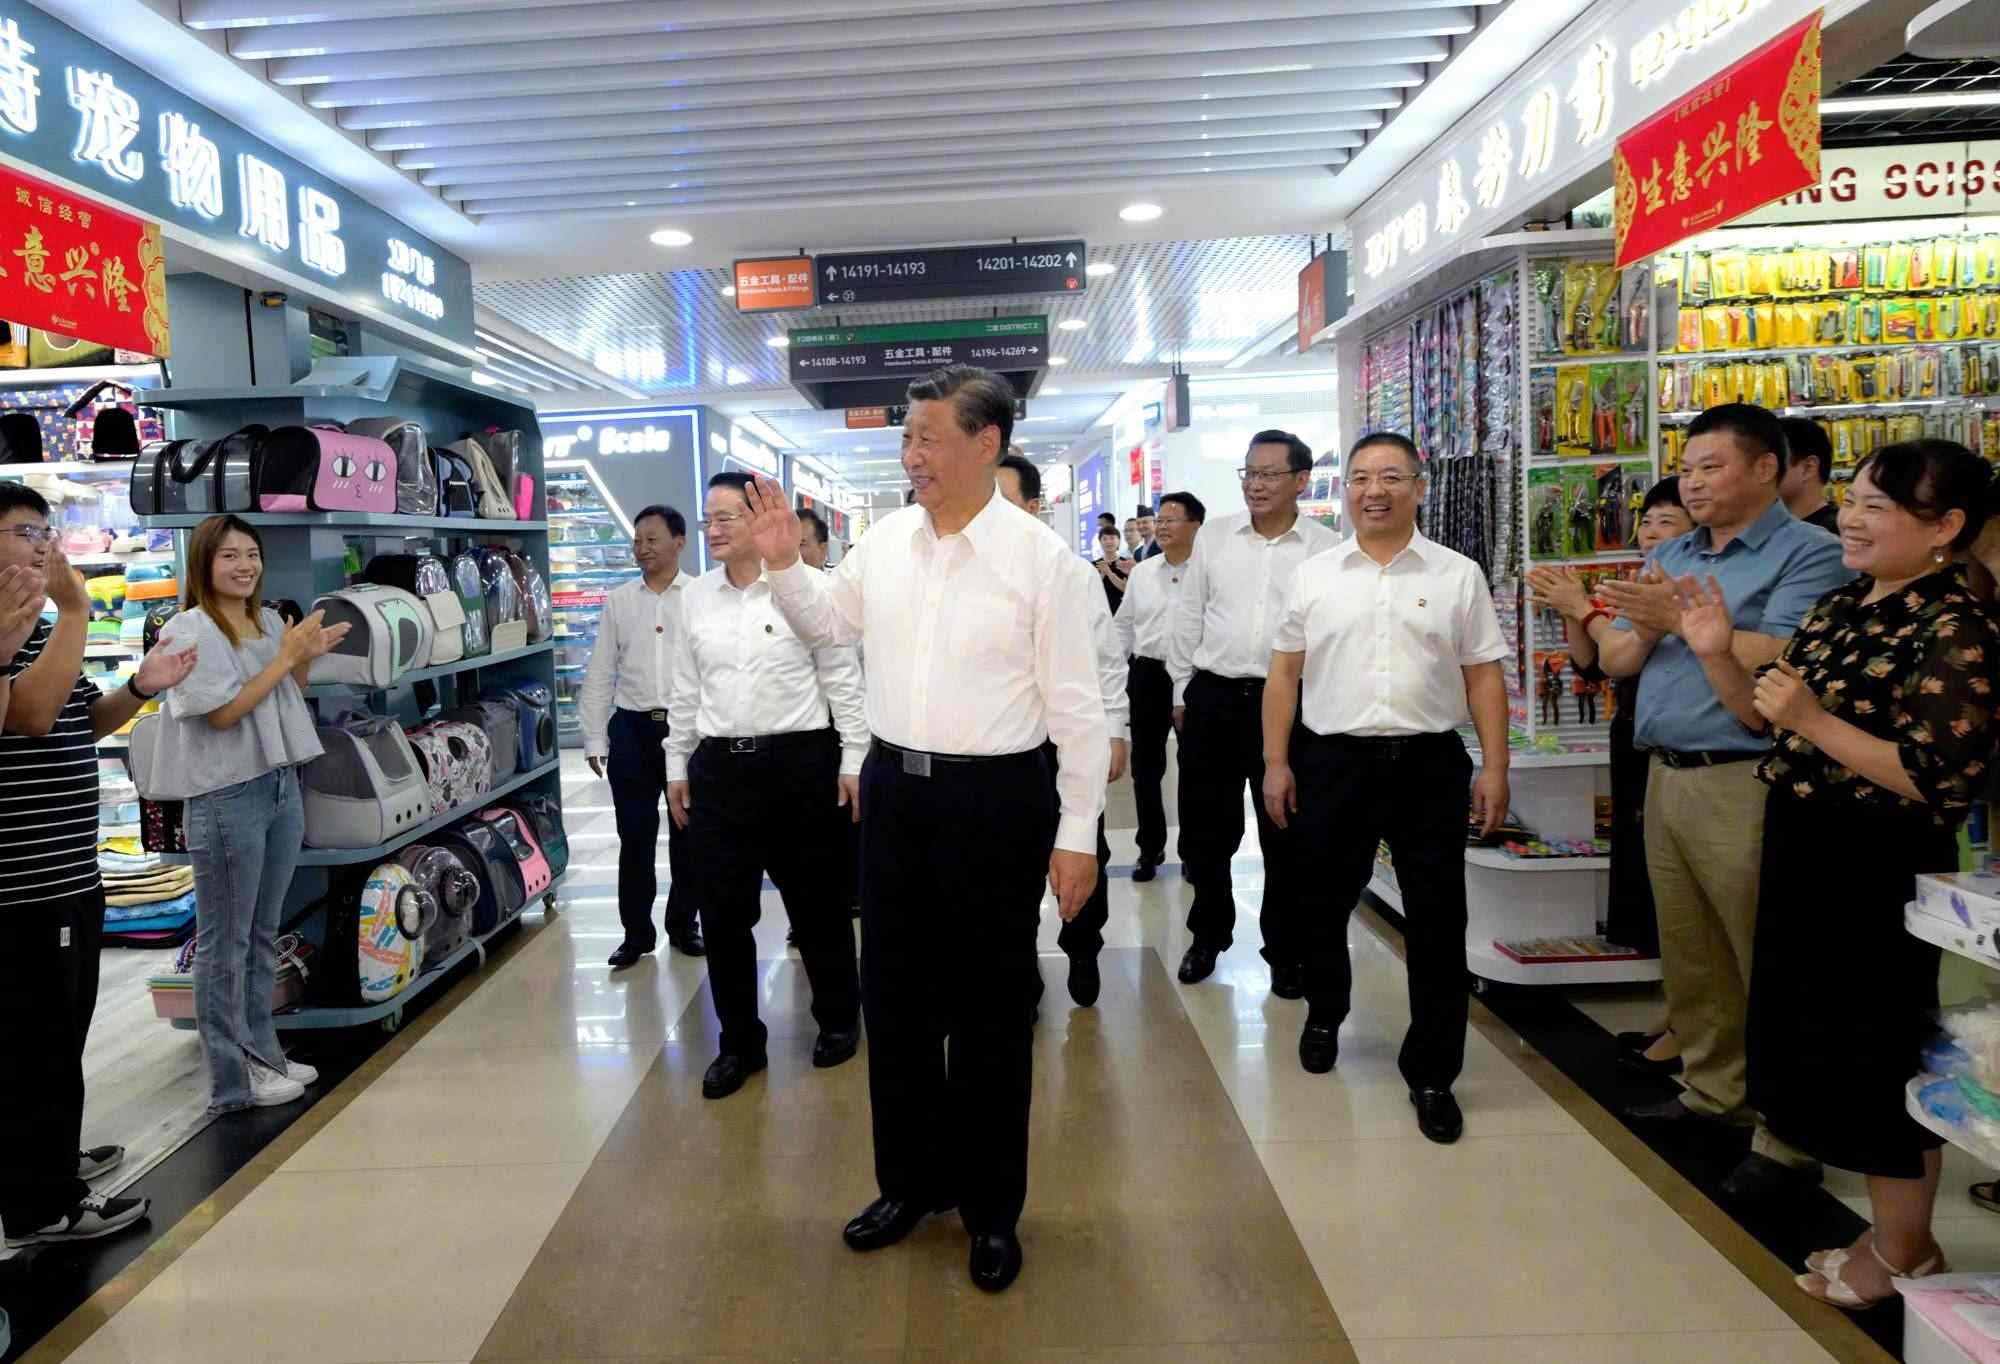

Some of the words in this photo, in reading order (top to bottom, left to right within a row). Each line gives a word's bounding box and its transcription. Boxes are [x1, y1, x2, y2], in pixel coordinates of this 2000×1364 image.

[1641, 99, 1774, 215] 生意兴隆
[1780, 167, 1857, 206] NG
[15, 186, 92, 229] 诚信经营
[0, 224, 139, 312] 意兴隆
[841, 262, 926, 279] 14191-14193
[976, 254, 1062, 271] 14201-14202
